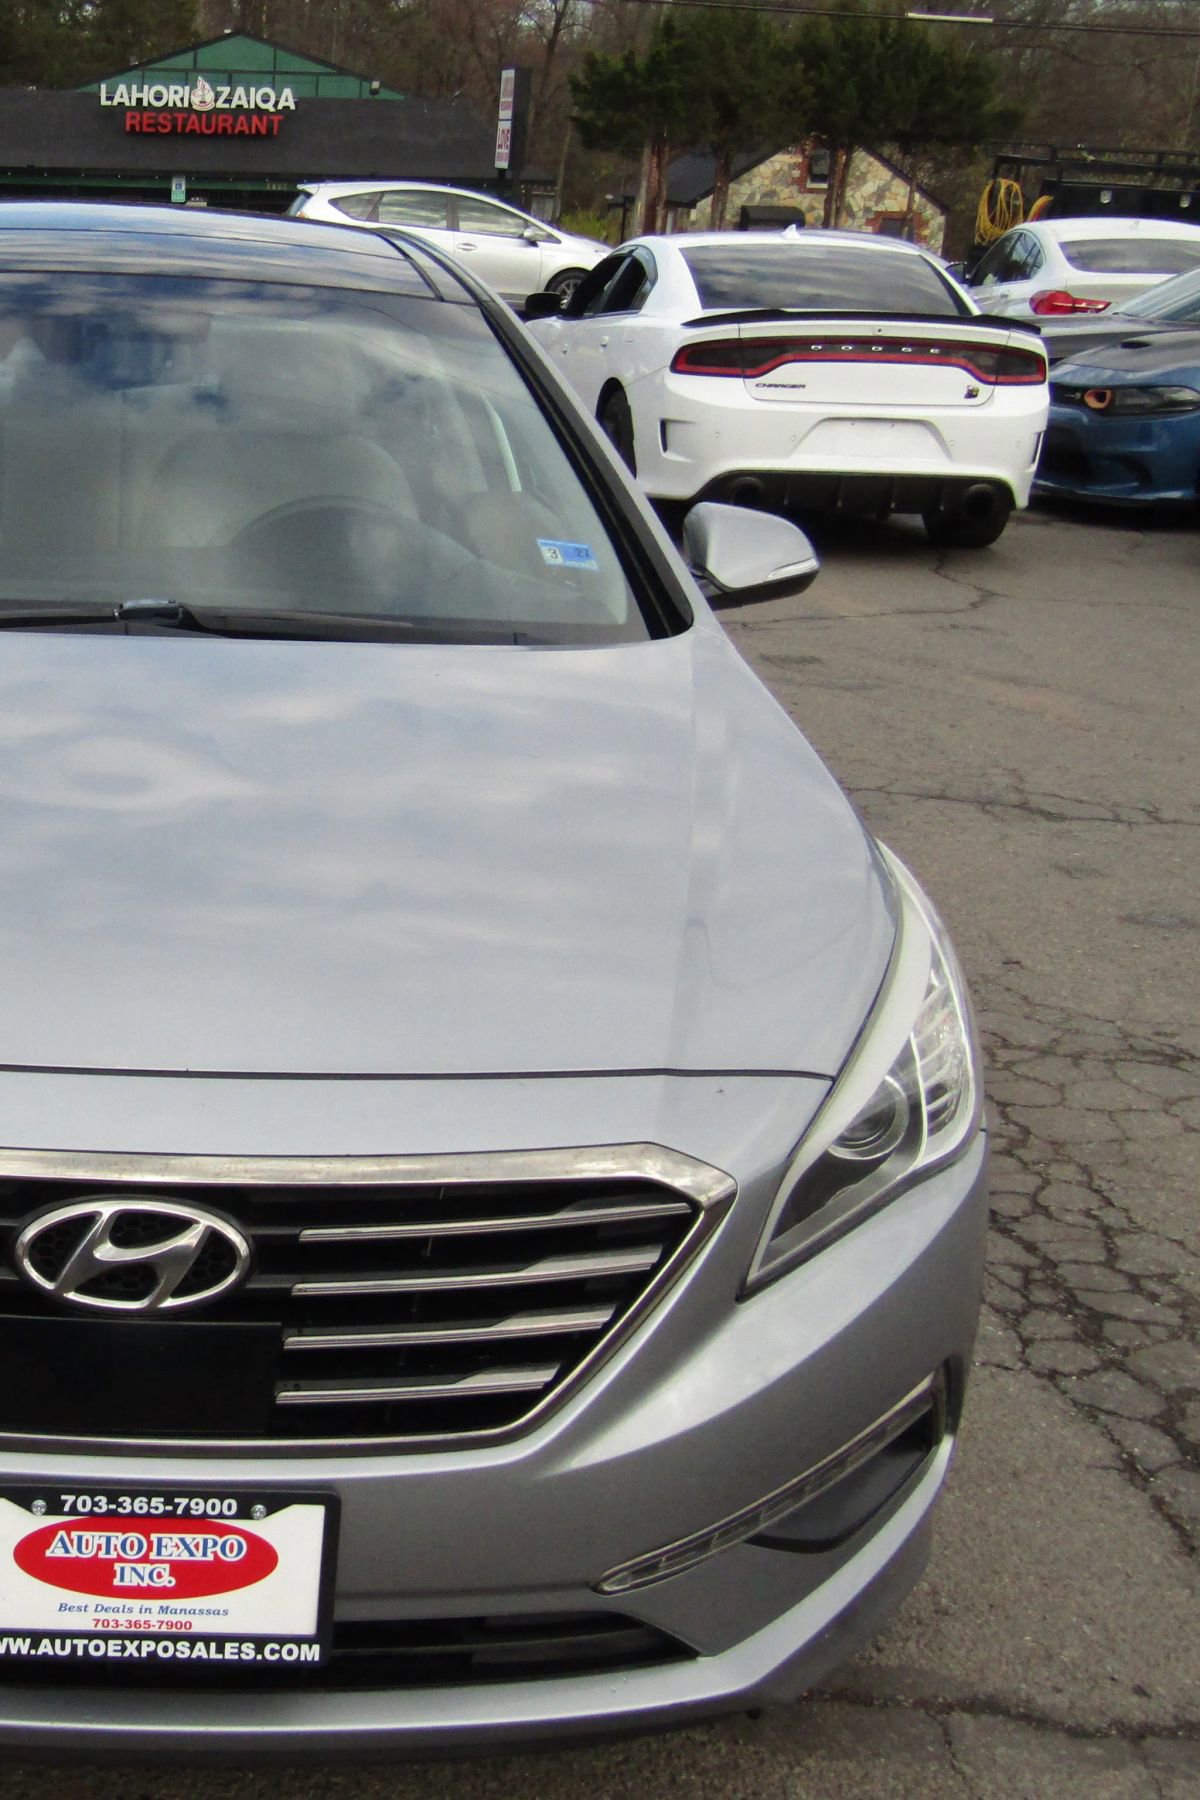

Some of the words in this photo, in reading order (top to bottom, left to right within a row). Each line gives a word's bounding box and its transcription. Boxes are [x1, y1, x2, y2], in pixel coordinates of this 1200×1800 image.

[100, 84, 190, 108] LAHORI
[217, 86, 296, 112] ZAIQA
[125, 111, 284, 135] RESTAURANT
[60, 1495, 238, 1516] 703-365-7900
[47, 1531, 147, 1560] AUTO
[150, 1533, 247, 1561] EXPO
[113, 1563, 176, 1587] INC.
[58, 1602, 89, 1613] Best
[94, 1603, 134, 1614] Deals
[139, 1605, 153, 1615] in
[158, 1605, 230, 1617] Manassas
[92, 1618, 193, 1631] 703-365-7900
